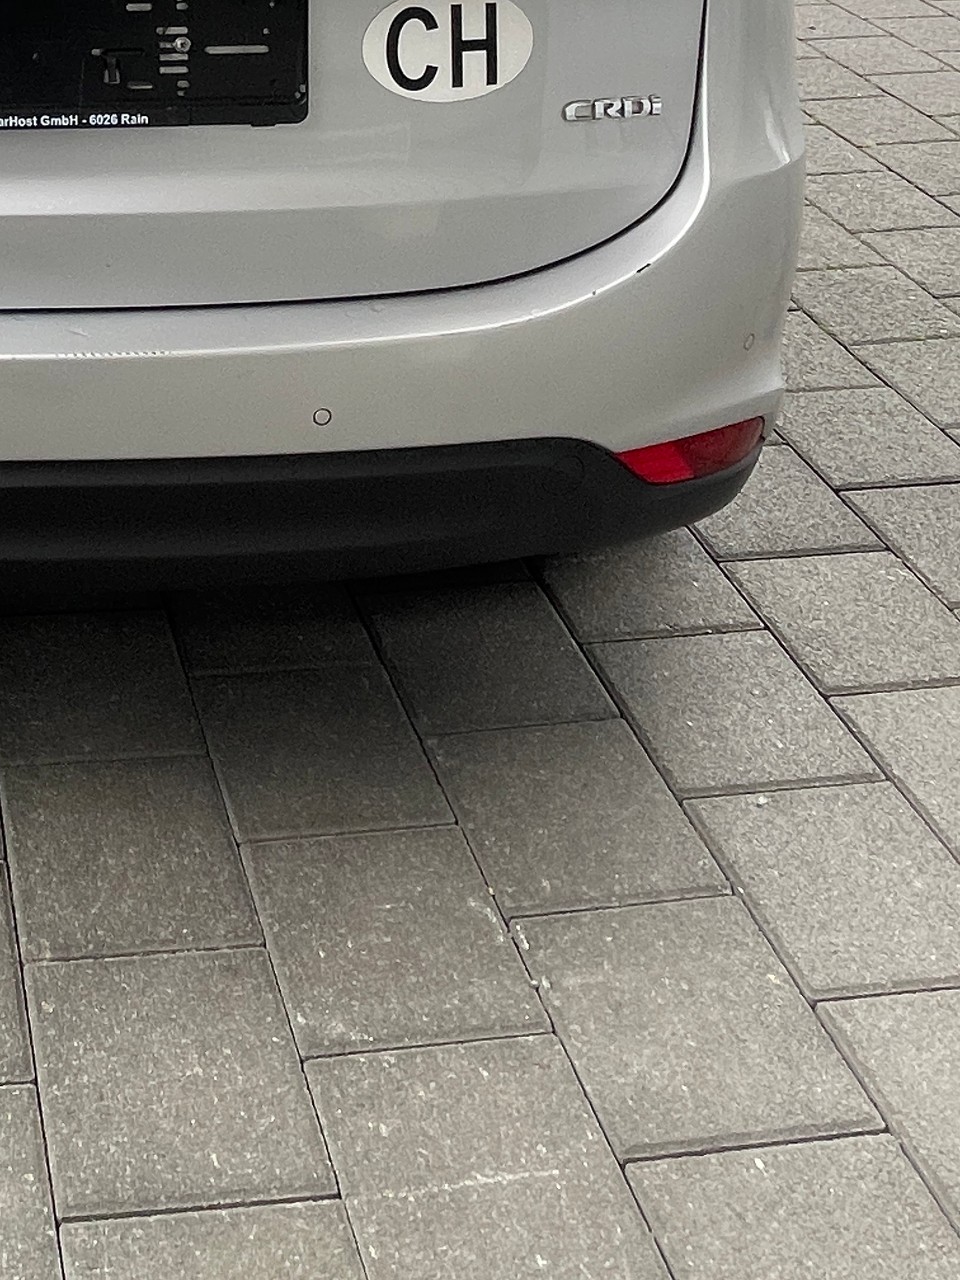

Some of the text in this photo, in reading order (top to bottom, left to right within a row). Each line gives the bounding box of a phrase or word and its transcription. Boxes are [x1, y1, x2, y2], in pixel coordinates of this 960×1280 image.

[386, 2, 498, 91] CH
[40, 114, 79, 126] GmbH
[89, 113, 118, 125] 6026
[120, 112, 149, 125] Rain
